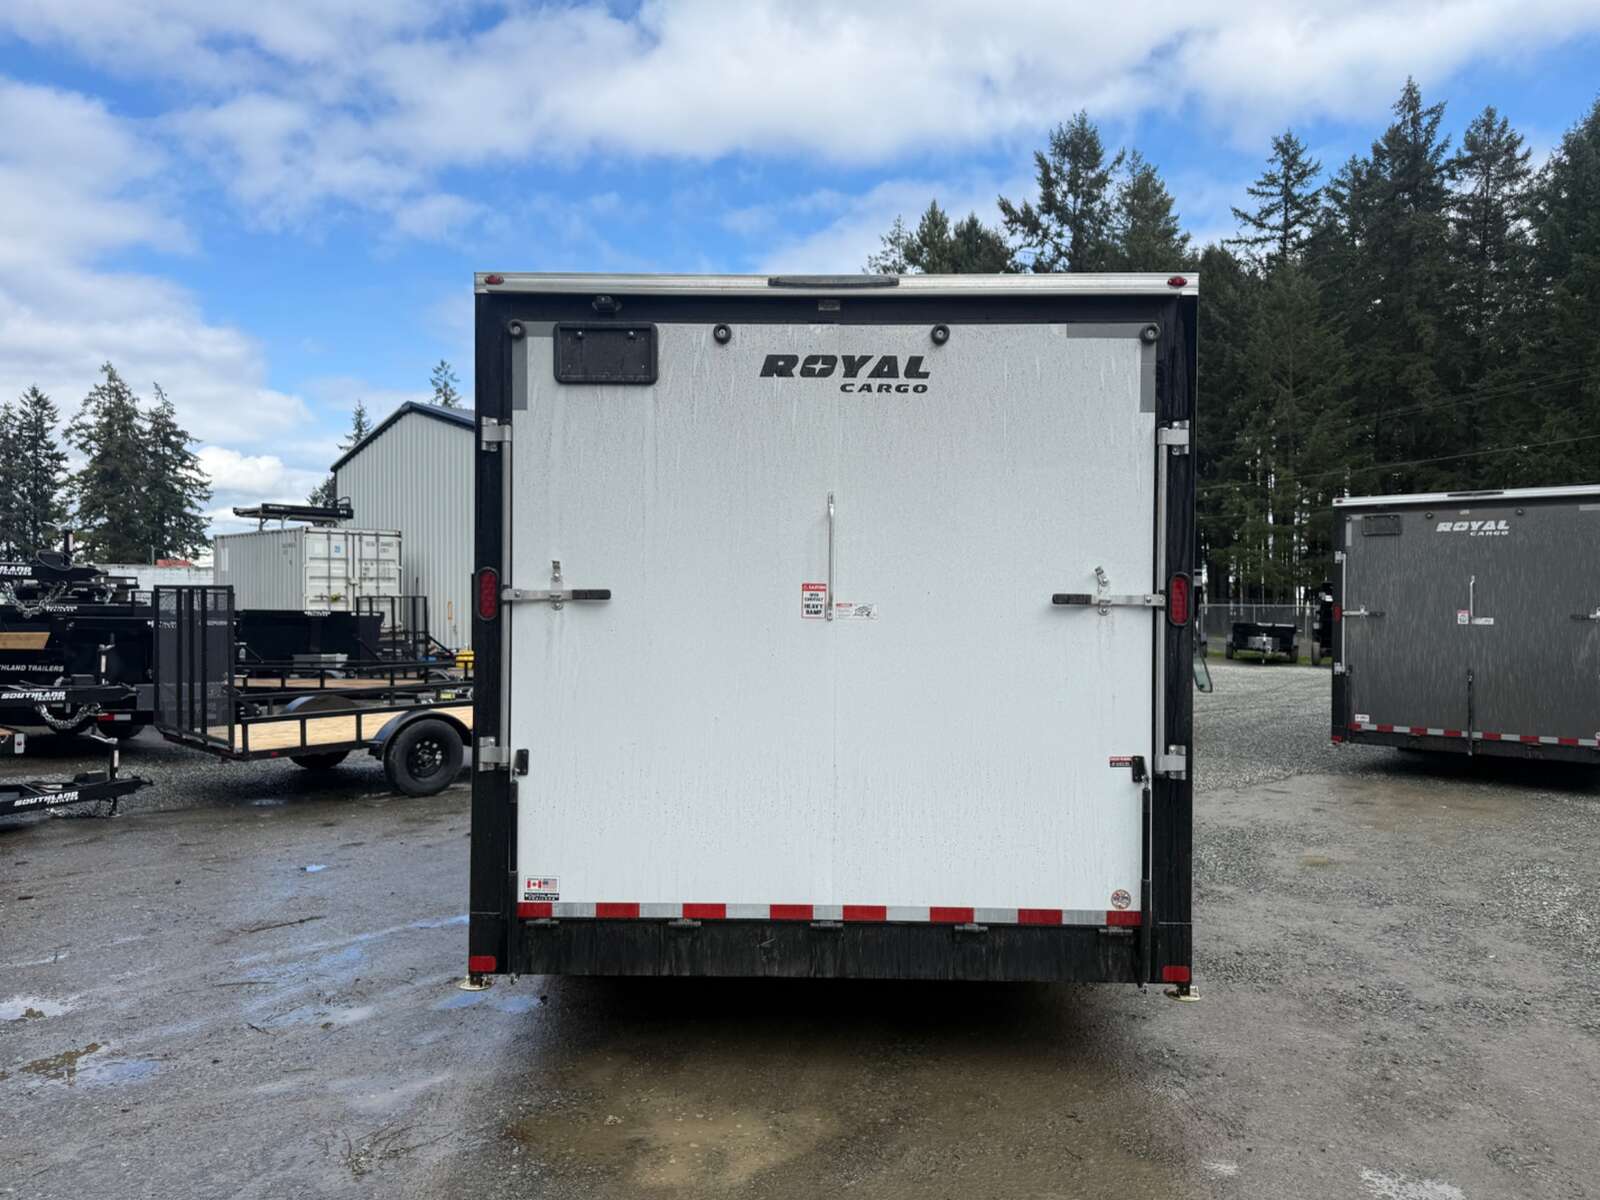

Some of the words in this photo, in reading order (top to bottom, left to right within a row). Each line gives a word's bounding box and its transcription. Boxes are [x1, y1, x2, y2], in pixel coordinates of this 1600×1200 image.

[760, 354, 931, 379] ROYAL
[840, 383, 929, 393] CARGO
[1436, 520, 1510, 532] ROYAL
[1, 691, 66, 700] SOUTHLAND
[14, 791, 79, 807] SOUTHLAND
